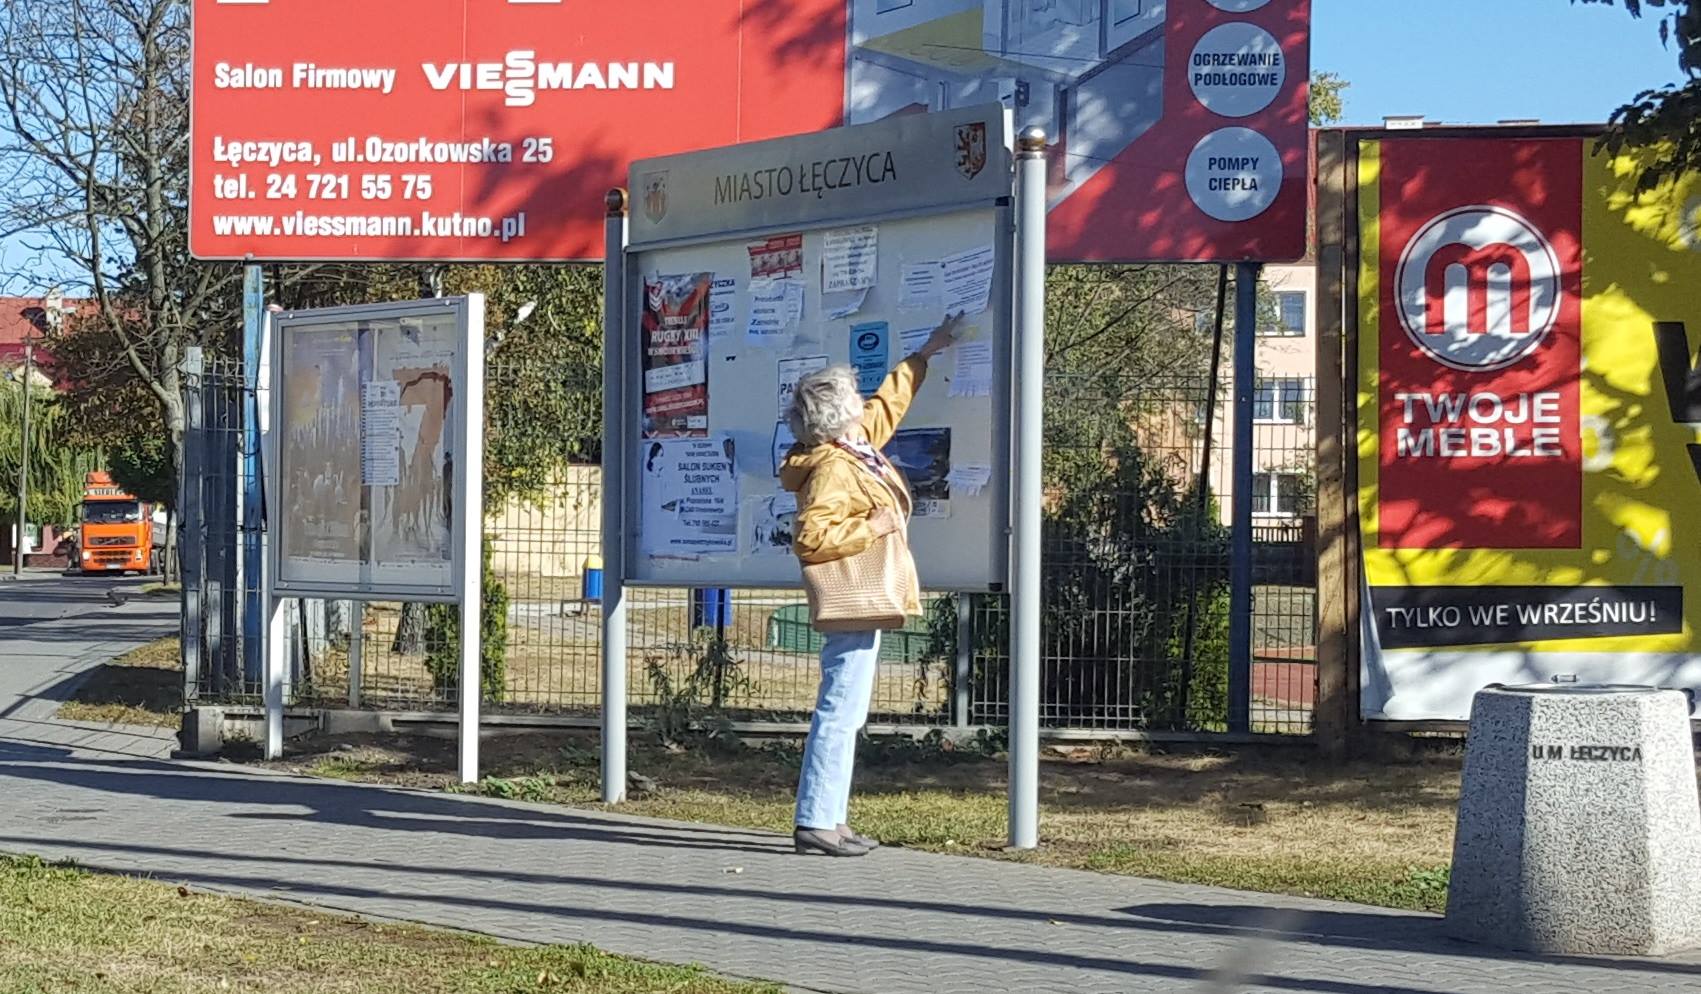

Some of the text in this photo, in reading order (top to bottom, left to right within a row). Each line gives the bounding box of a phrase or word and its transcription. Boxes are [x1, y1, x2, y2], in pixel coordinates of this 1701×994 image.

[1193, 52, 1280, 67] OGRZEWANIE
[214, 61, 396, 93] Salon Firmowy
[422, 50, 675, 107] VIESSMANN
[1194, 72, 1278, 87] PODŁOGOWE
[213, 136, 554, 167] Łęczyca, ul.Ozorkowska 25
[1207, 156, 1260, 172] POMPY
[213, 174, 432, 199] tel. 24 721 55 75
[713, 150, 897, 206] MIASTO ŁĘCZYCA
[1207, 177, 1259, 192] CIEPŁA
[213, 212, 526, 241] www.viessmann.kutno.pl
[651, 329, 682, 343] RUGBY
[1394, 392, 1562, 424] TWOJE
[1396, 428, 1562, 458] MEBLE
[678, 462, 727, 471] SALON SUKIEN
[1386, 596, 1656, 628] TYLKO WE WRZEŚNIU!
